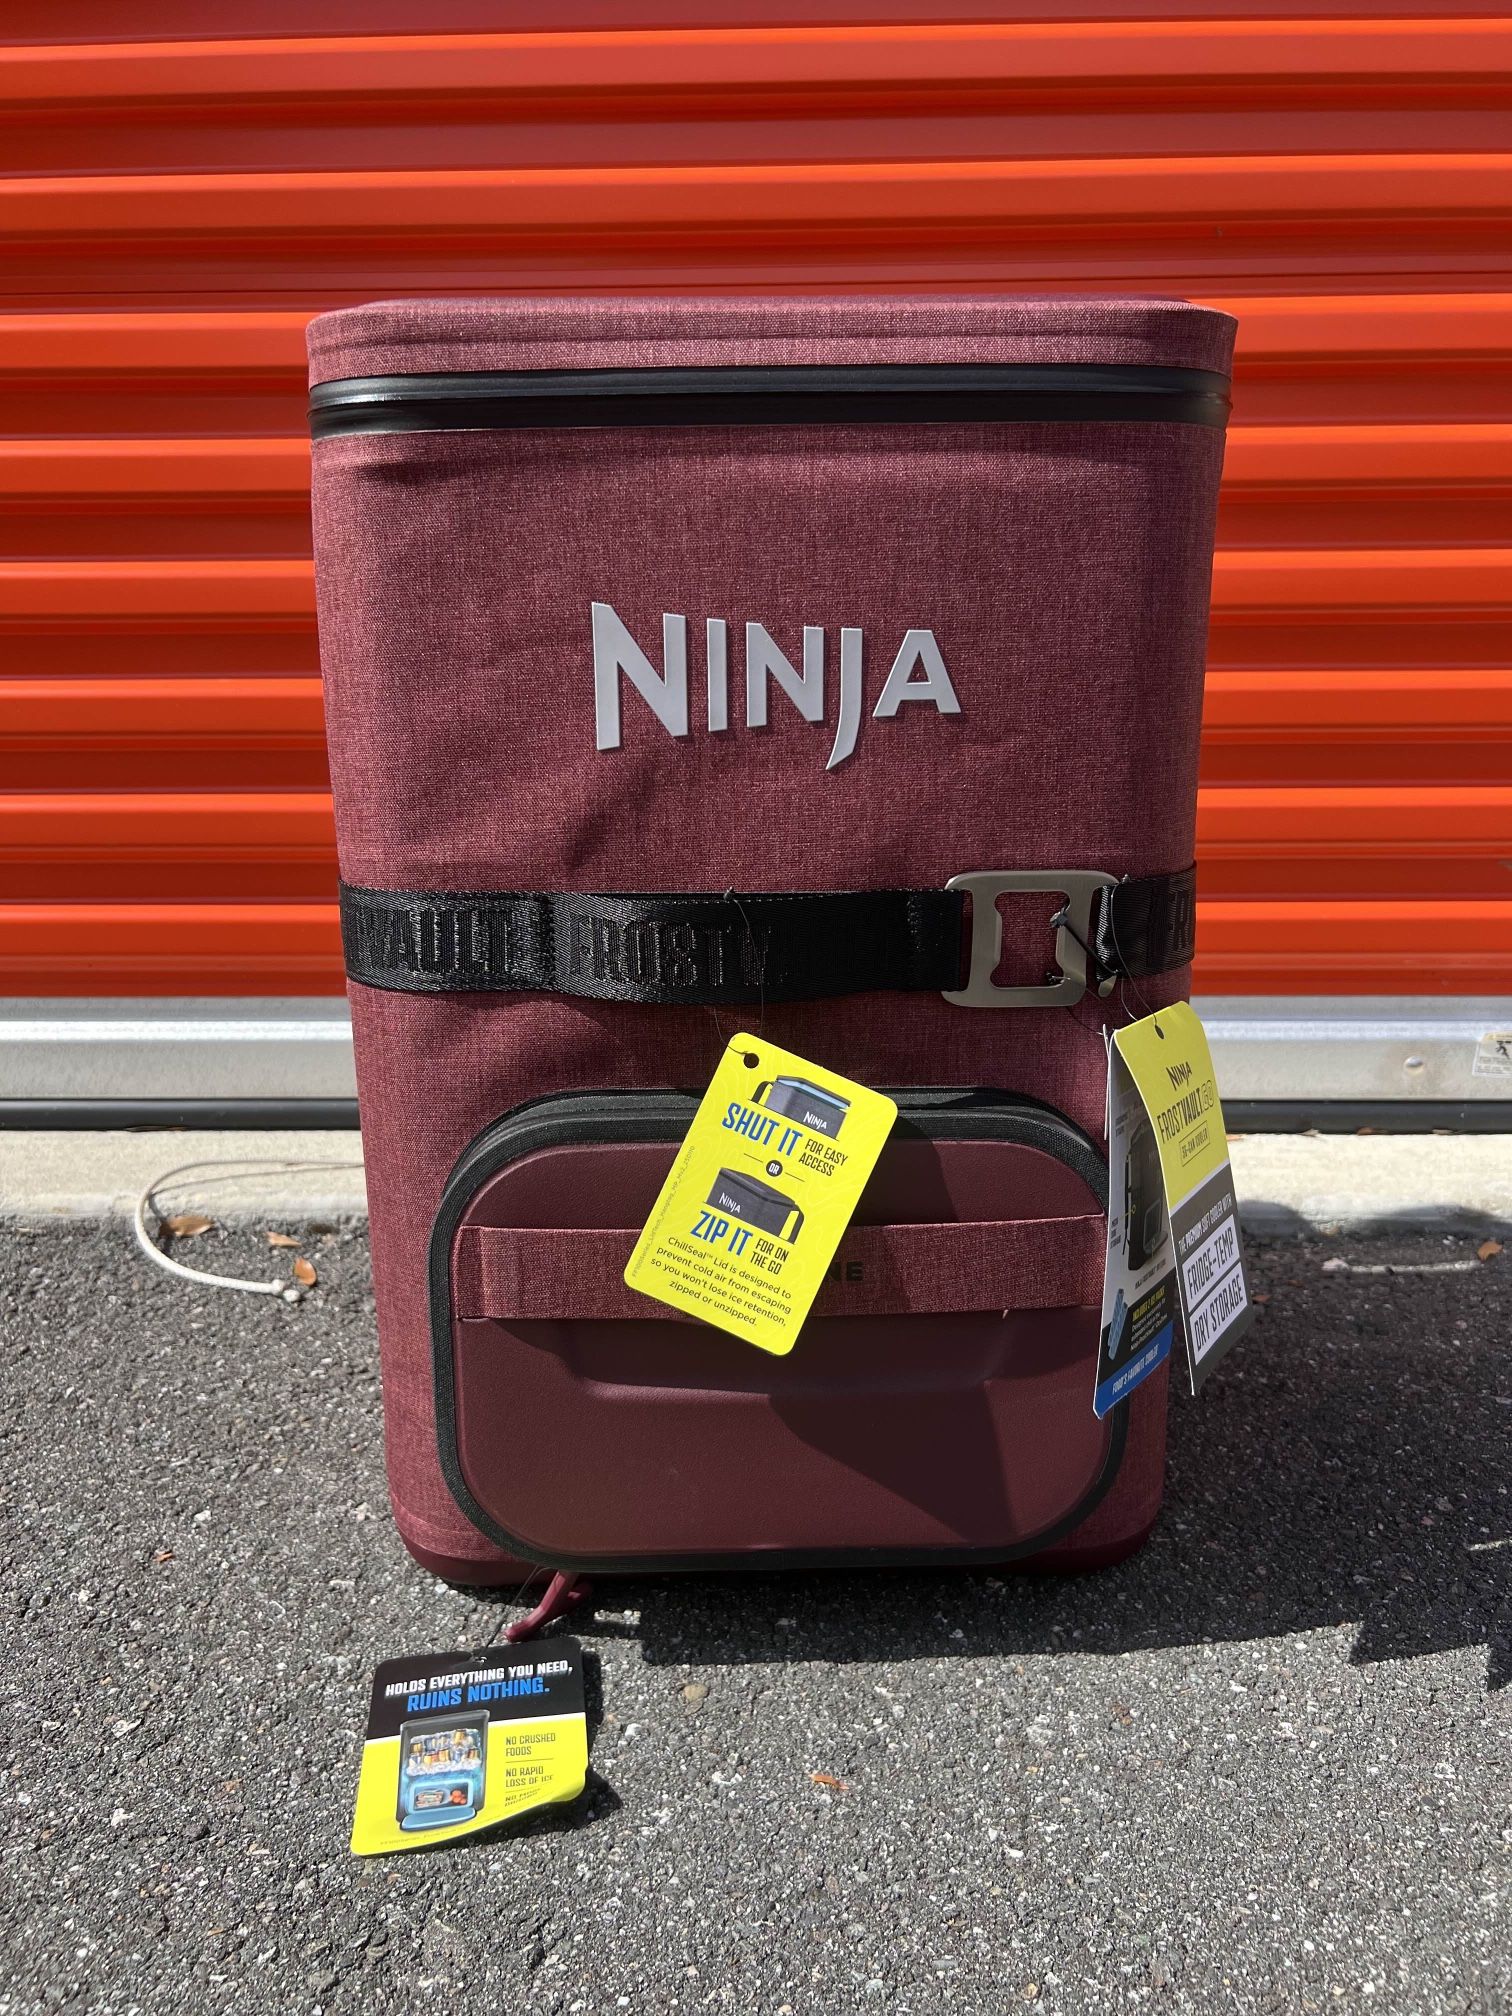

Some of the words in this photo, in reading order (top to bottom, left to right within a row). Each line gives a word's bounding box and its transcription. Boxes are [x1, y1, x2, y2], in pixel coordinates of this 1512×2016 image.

[591, 601, 962, 770] NINJA
[1166, 1061, 1192, 1092] NINJA
[721, 1102, 780, 1146] SHUT
[777, 1127, 804, 1156] IT
[805, 1138, 825, 1156] FOR
[823, 1147, 849, 1167] EASY
[803, 1111, 827, 1129] NINJA
[768, 1162, 779, 1175] OR
[798, 1152, 835, 1177] ACCESS
[719, 1192, 741, 1213] NINJA
[690, 1210, 730, 1244] ZIP
[727, 1226, 754, 1256] IT
[755, 1238, 775, 1256] FOR
[775, 1246, 790, 1263] ON
[713, 1257, 728, 1270] Lid
[730, 1265, 737, 1275] is
[738, 1267, 781, 1294] designed
[782, 1290, 792, 1299] to
[750, 1250, 767, 1269] THE
[767, 1260, 783, 1275] GO
[1187, 1226, 1234, 1300] FRIDGE-TEMP
[650, 1258, 662, 1268] so
[664, 1264, 681, 1277] you
[682, 1271, 708, 1288] won't
[708, 1283, 728, 1298] lose
[729, 1292, 743, 1304] ice
[743, 1300, 787, 1327] retention,
[656, 1247, 692, 1267] prevent
[693, 1262, 714, 1277] cold
[714, 1271, 727, 1283] air
[728, 1278, 750, 1294] from
[751, 1290, 792, 1315] escaping
[669, 1280, 701, 1299] zipped
[702, 1296, 712, 1305] or
[713, 1301, 758, 1326] unzipped.
[1194, 1310, 1210, 1352] DRY
[1209, 1273, 1244, 1332] STORAGE
[385, 1677, 426, 1697] HOLDS
[429, 1667, 505, 1690] EVERYTHING
[508, 1664, 534, 1678] YOU
[536, 1660, 573, 1675] NEED,
[407, 1688, 462, 1712] RUINS
[468, 1677, 550, 1703] NOTHING.
[505, 1736, 517, 1746] NO
[519, 1732, 556, 1745] CRUSHED
[505, 1746, 532, 1757] FOODS
[505, 1767, 517, 1778] NO
[519, 1766, 544, 1776] RAPID
[505, 1778, 526, 1788] LOSS
[528, 1776, 540, 1785] OF
